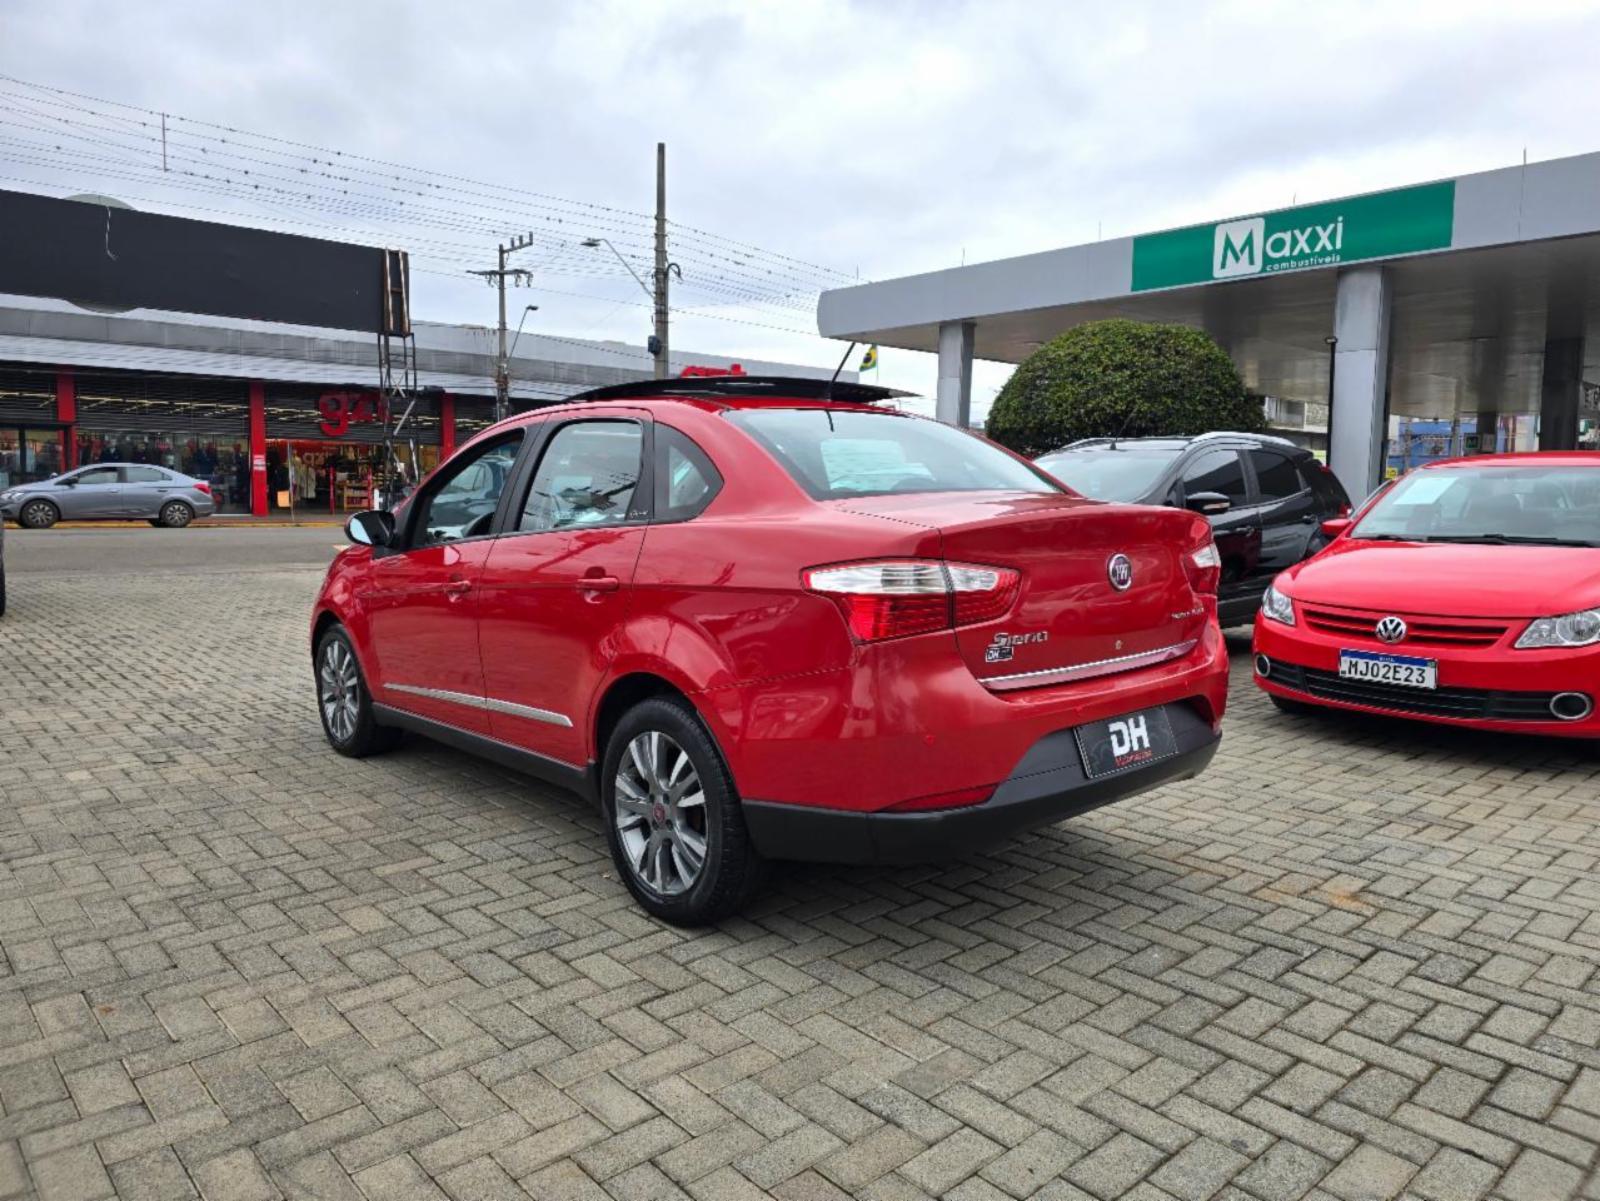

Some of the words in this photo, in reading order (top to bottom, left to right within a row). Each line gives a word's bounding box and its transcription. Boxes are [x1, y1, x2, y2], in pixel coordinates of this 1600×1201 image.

[1220, 216, 1343, 270] Maxxi
[1266, 253, 1341, 271] combustíveis
[1107, 714, 1151, 757] DH
